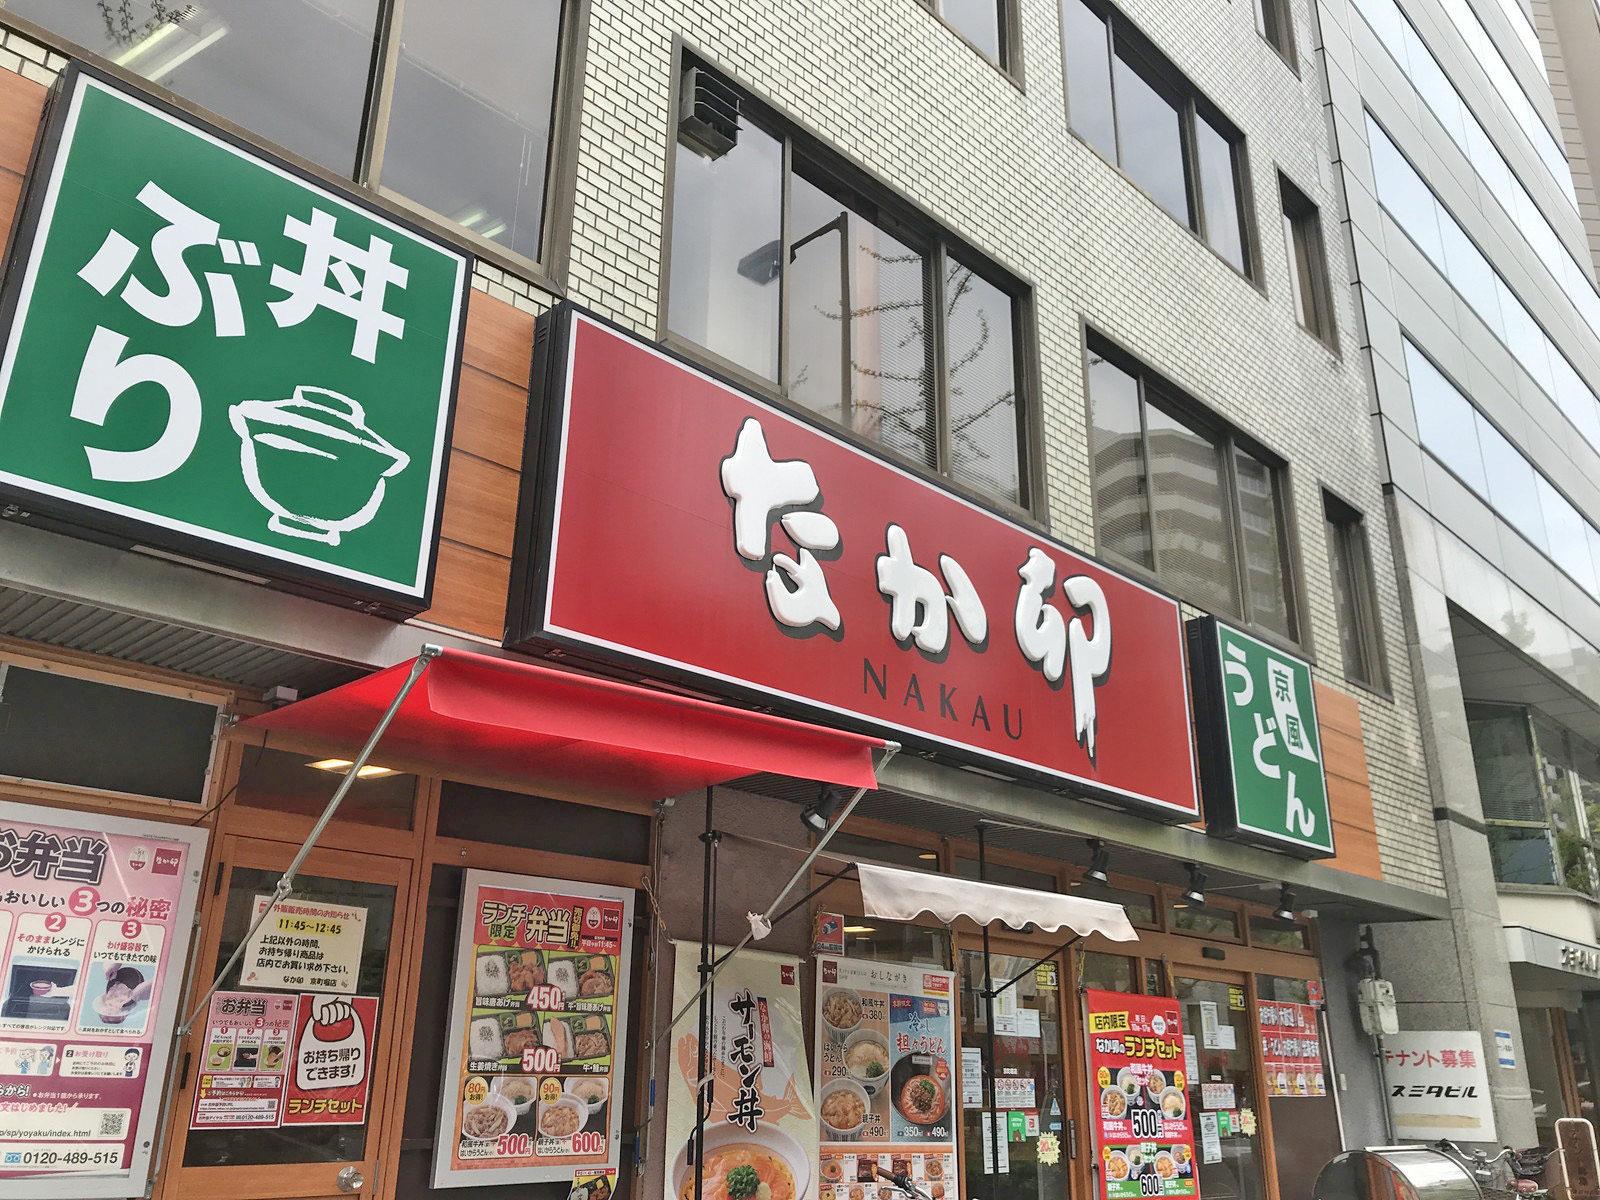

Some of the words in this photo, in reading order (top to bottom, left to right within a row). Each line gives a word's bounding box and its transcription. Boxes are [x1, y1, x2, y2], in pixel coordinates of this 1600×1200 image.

[266, 207, 410, 363] 丼
[721, 417, 1112, 758] なか卯
[863, 657, 1023, 740] NAKAU
[1273, 669, 1303, 751] 京風
[1225, 641, 1315, 838] うどん
[481, 901, 527, 926] ランチ
[525, 906, 572, 944] 弁当
[489, 923, 516, 939] 限定
[17, 933, 85, 947] そのままレンジに
[106, 940, 149, 952] わけ盛容器で
[27, 946, 71, 957] かけられる
[93, 951, 158, 963] いつでもできたての味
[258, 947, 325, 961] お持ち帰り商品は
[256, 958, 349, 975] 店内でお買い求め下さい。
[871, 969, 908, 984] おしながき
[221, 997, 268, 1017] お弁当
[1094, 1014, 1127, 1030] 店内限定
[823, 1042, 849, 1055] はいから
[896, 1032, 946, 1054] 担々うどん
[303, 1048, 361, 1065] お持ち帰り
[729, 987, 764, 1132] サーモン丼
[823, 1054, 843, 1063] うどん
[1385, 1049, 1477, 1068] テナント募集
[305, 1063, 356, 1081] できます!
[468, 1082, 486, 1093] 80円
[543, 1082, 560, 1093] 90円
[1391, 1085, 1479, 1098] スミタビル
[288, 1098, 363, 1114] ランチセット
[862, 1114, 881, 1123] 親子丼
[23, 1151, 118, 1164] 0120-489-515
